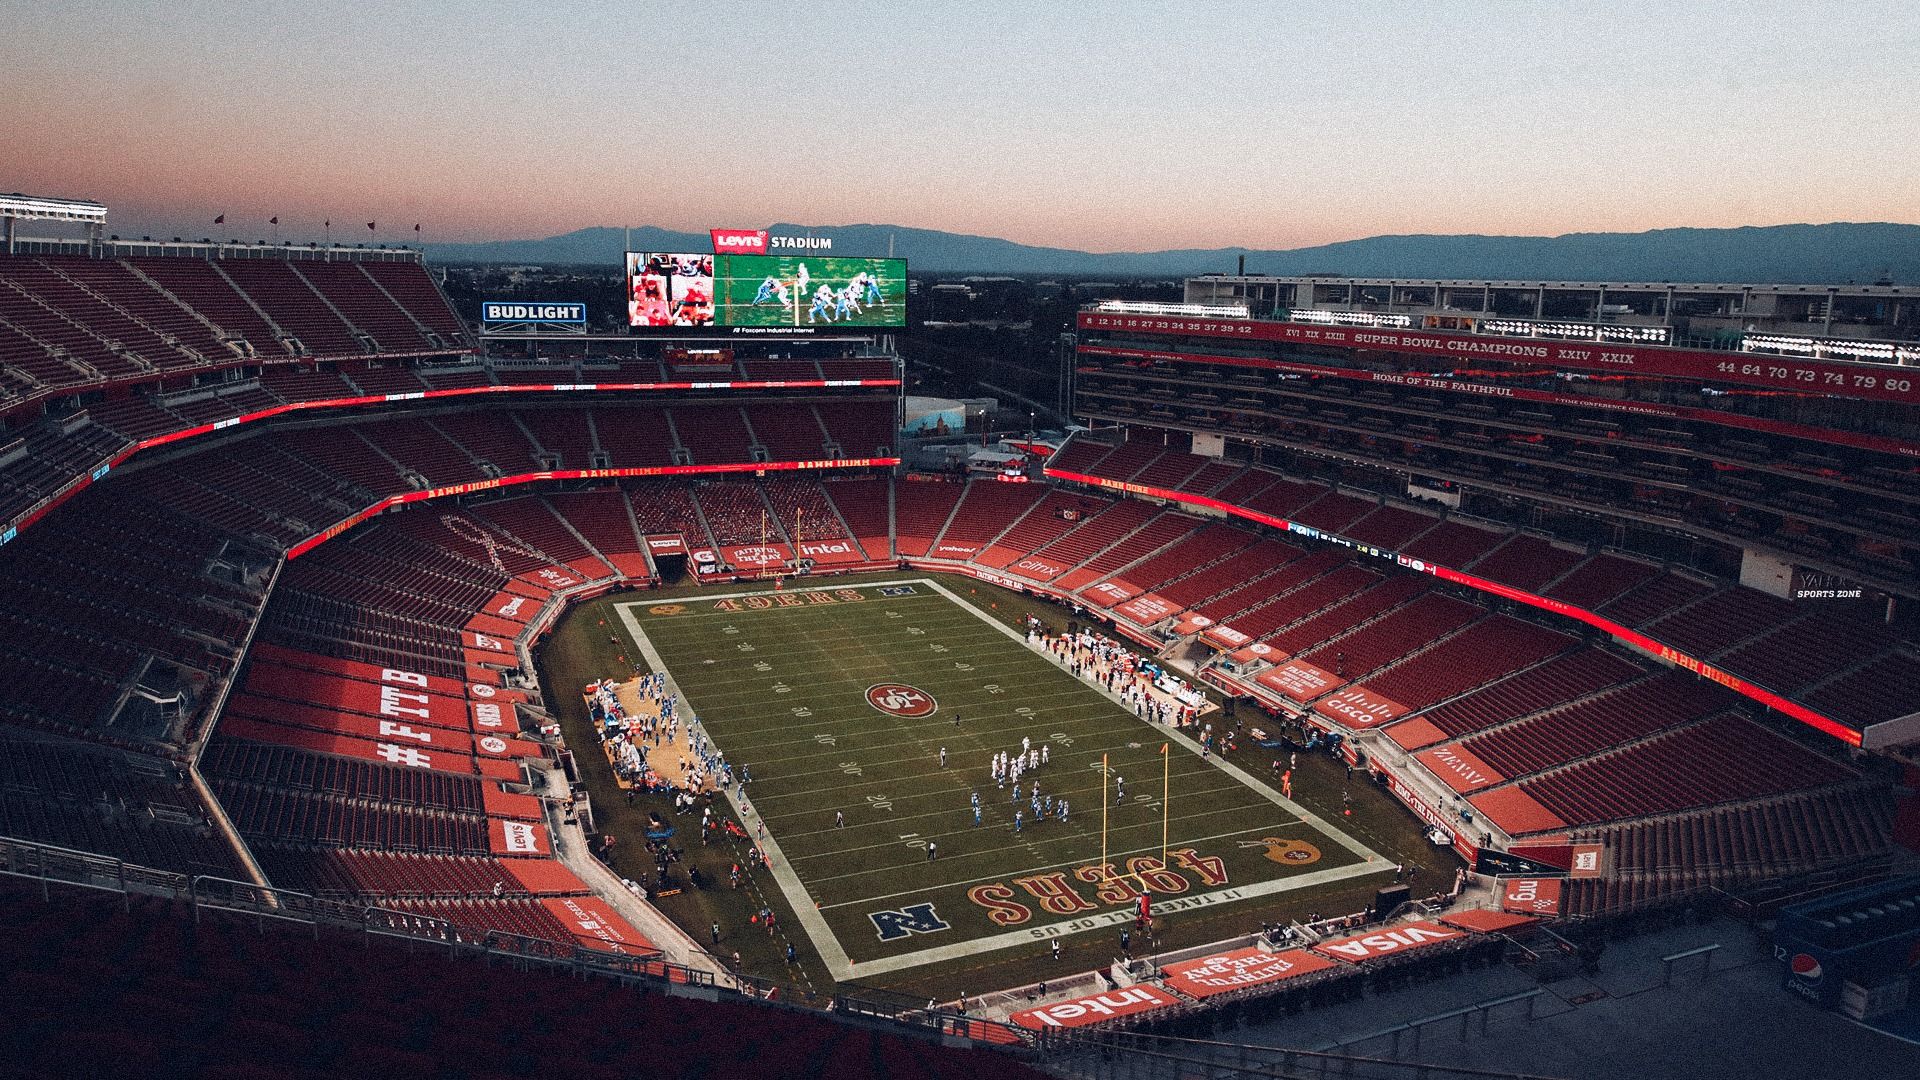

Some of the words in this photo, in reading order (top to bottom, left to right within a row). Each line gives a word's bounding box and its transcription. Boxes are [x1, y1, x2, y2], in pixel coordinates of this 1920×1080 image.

[771, 237, 832, 248] STADIUM
[1141, 320, 1152, 328] 27
[1172, 322, 1184, 330] 34
[1204, 324, 1217, 332] 37
[1220, 324, 1234, 332] 39
[1238, 326, 1252, 334] 42
[1286, 329, 1300, 337] XVI
[1305, 330, 1319, 338] XIX
[1354, 334, 1398, 346] SUPER
[1402, 338, 1444, 350] BOWL
[1447, 340, 1548, 357] CHAMPIONS
[1558, 350, 1591, 360] XXIV
[1600, 352, 1634, 364] XXIX
[1372, 373, 1404, 384] HOME
[1406, 376, 1422, 384] OF
[1424, 379, 1448, 388] THE
[1452, 382, 1514, 397] FAITHFUL
[1716, 362, 1736, 372] 44
[1742, 364, 1761, 376] 64
[1769, 366, 1788, 378] 70
[1796, 369, 1816, 382] 73
[1824, 372, 1845, 386] 74
[1853, 375, 1877, 388] 79
[1884, 378, 1911, 392] 80
[406, 392, 424, 400] DOWN
[1580, 400, 1628, 411] CONFERENCE
[1628, 405, 1676, 416] CHAMPIONS
[734, 547, 780, 556] FAITHFUL
[800, 542, 851, 555] intel
[714, 588, 865, 612] 49ERS
[1797, 590, 1835, 598] SPORTS
[1837, 590, 1862, 598] ZONE
[866, 794, 892, 808] 20
[1394, 780, 1410, 802] HOME
[1414, 797, 1426, 816] THE
[899, 833, 926, 847] 10
[967, 848, 1228, 927] 49ERS
[1223, 890, 1242, 899] IT
[1508, 880, 1538, 901] nrg
[1151, 895, 1216, 914] TAKES
[1030, 927, 1061, 938] US
[1070, 919, 1095, 930] OF
[1327, 928, 1456, 956] VISA
[1230, 954, 1280, 968] THE
[1182, 962, 1226, 980] BAY
[1193, 960, 1293, 986] FAITHFUL
[1032, 988, 1163, 1026] intel
